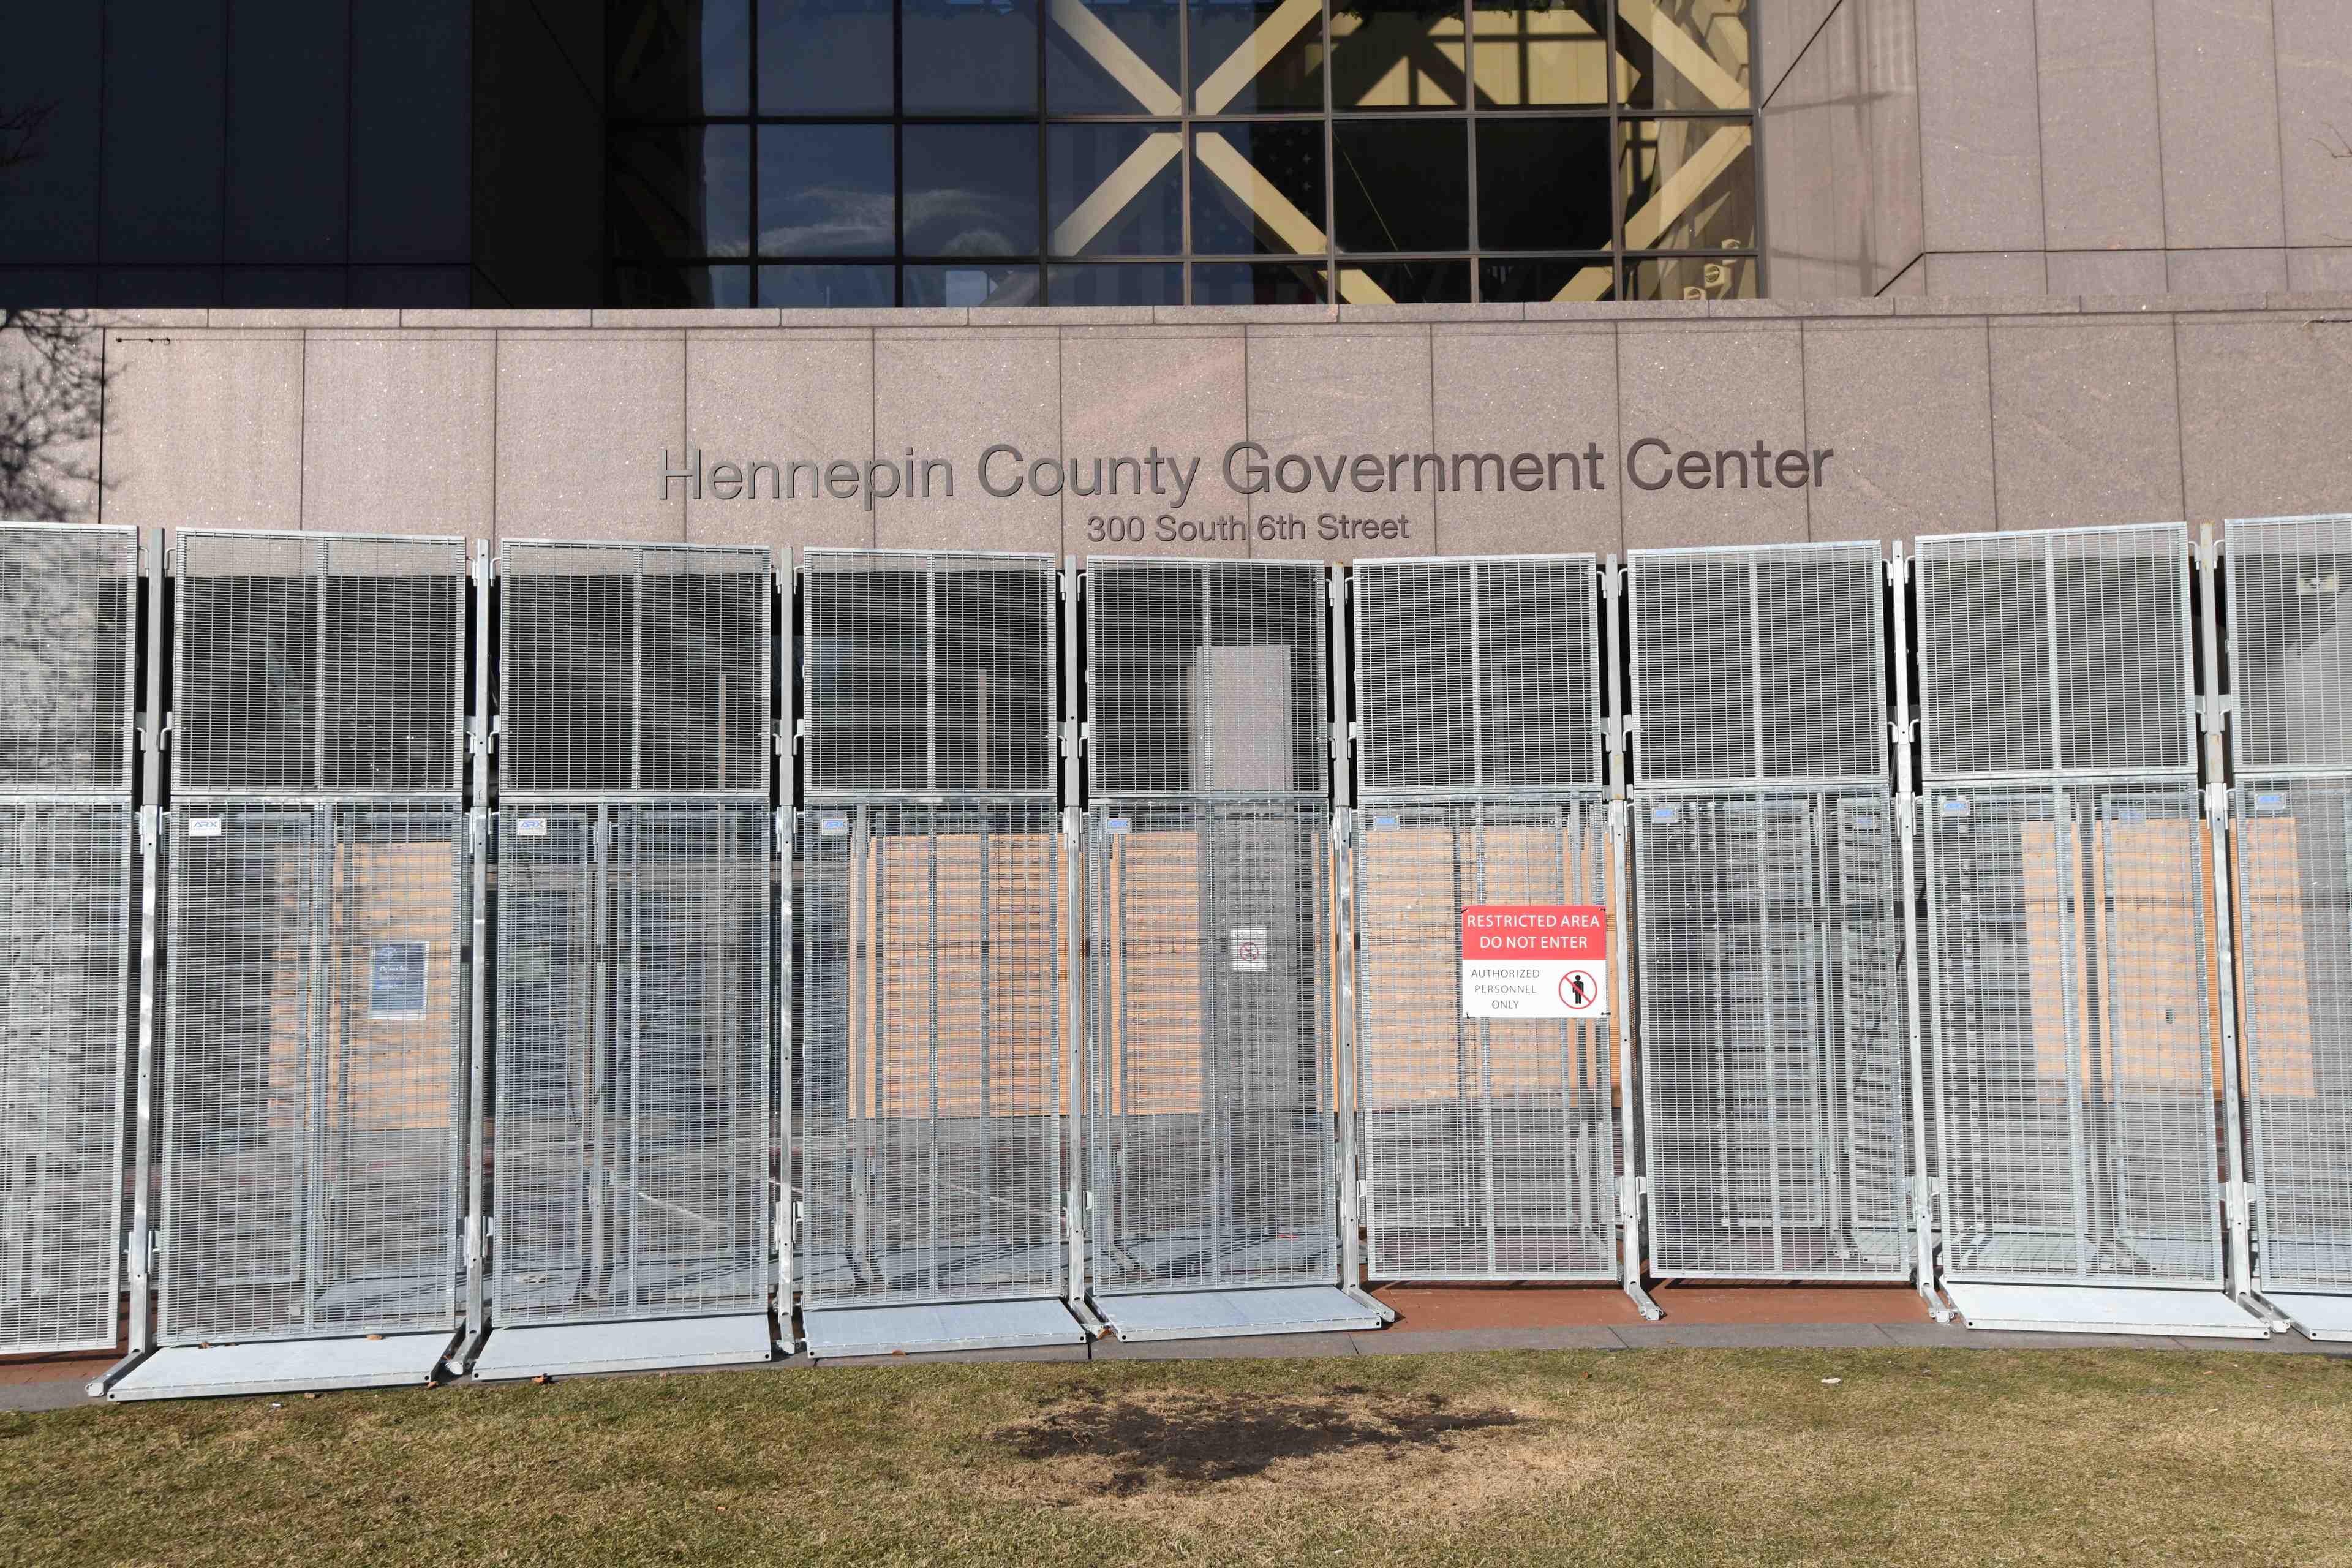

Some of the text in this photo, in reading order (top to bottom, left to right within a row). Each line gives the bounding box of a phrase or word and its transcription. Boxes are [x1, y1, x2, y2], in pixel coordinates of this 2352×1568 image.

[658, 437, 1834, 510] Hennepin County Government Center
[1087, 512, 1410, 542] 300 South 6th Street
[1468, 914, 1600, 927] RESTRICTED AREA
[1480, 936, 1588, 949] DO NOT ENTER
[1471, 969, 1540, 979] AUTHORIZED
[1474, 984, 1537, 994] PERSONNEL
[1491, 1000, 1520, 1009] ONLY
